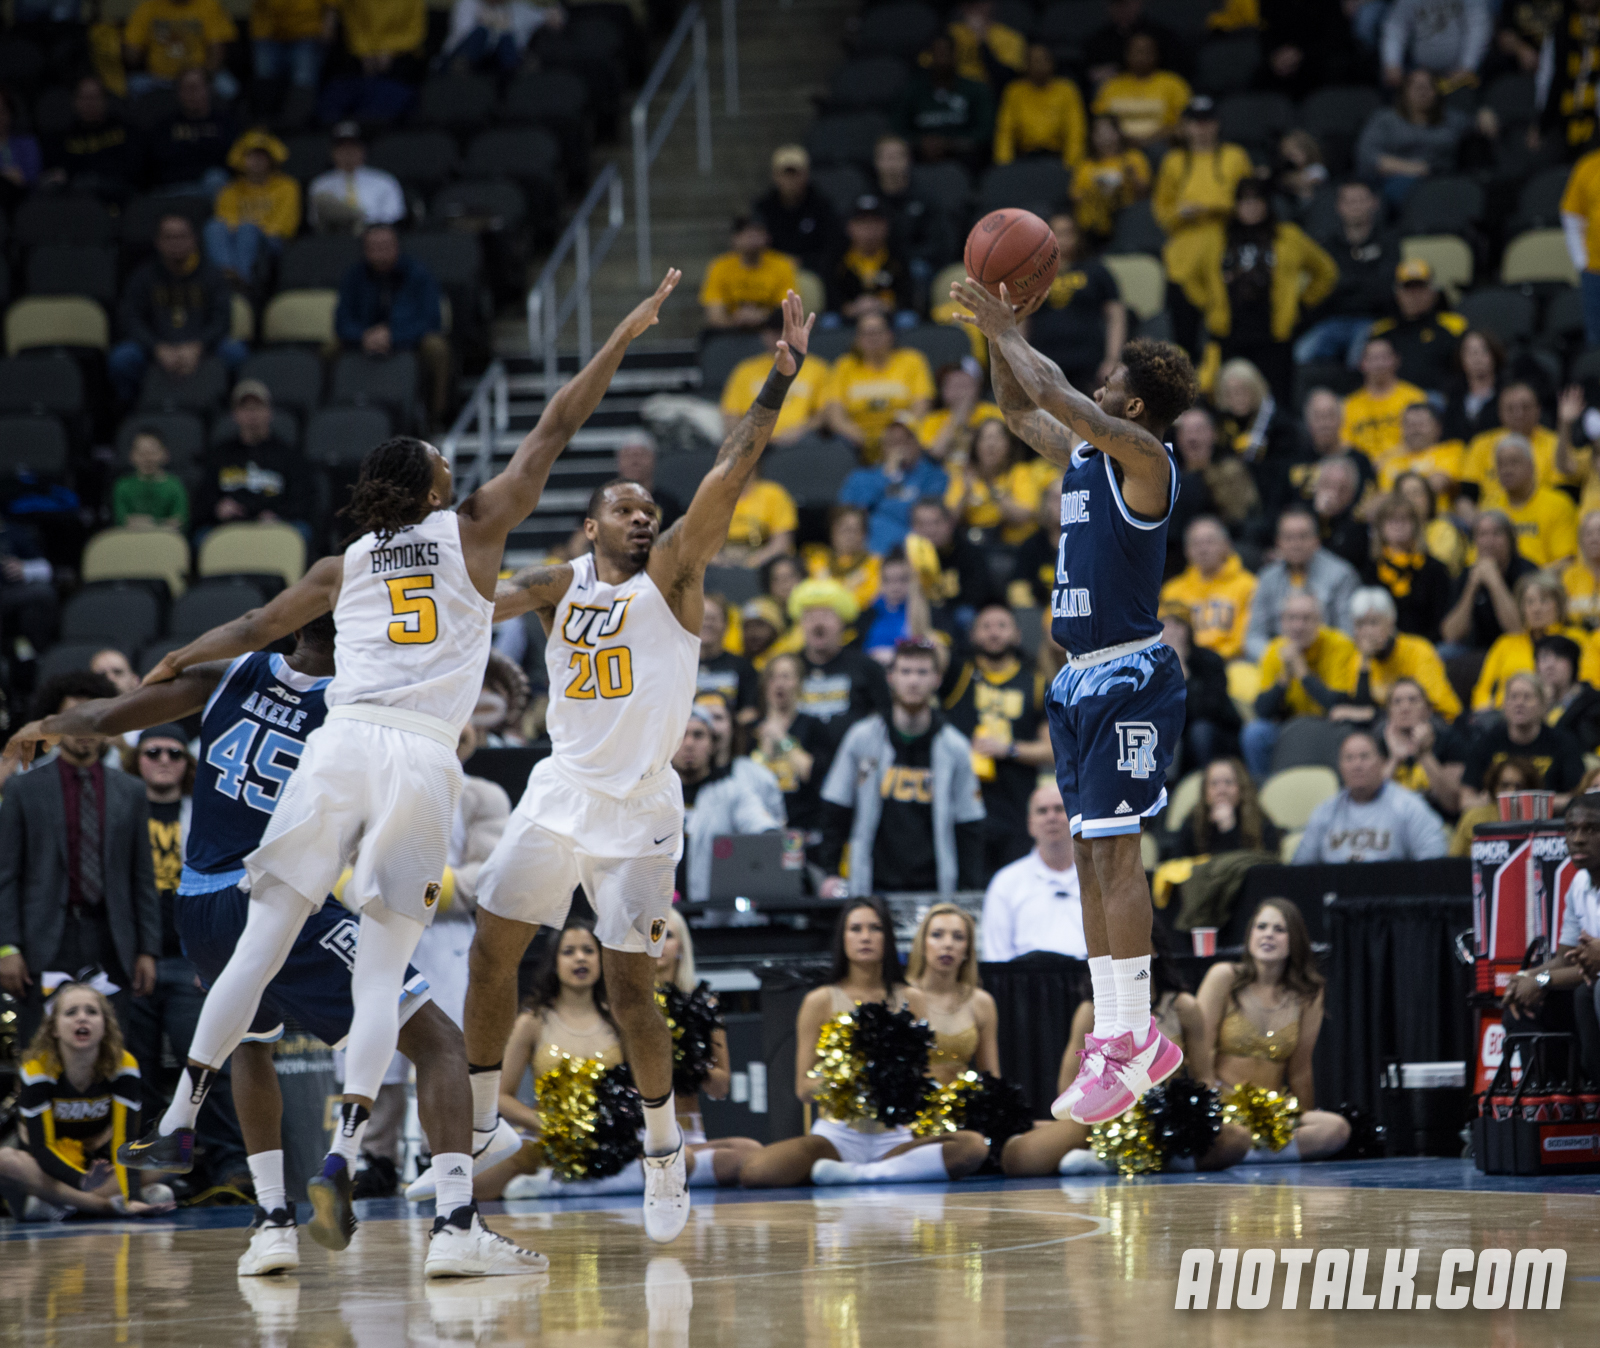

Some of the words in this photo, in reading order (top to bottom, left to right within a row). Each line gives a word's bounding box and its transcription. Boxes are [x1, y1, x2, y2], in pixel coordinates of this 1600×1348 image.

[1014, 245, 1060, 290] SPALDING
[370, 542, 440, 575] BROOKS
[1056, 532, 1070, 585] 1
[384, 573, 439, 645] 5
[561, 591, 639, 650] VCU
[565, 645, 634, 700] 20
[241, 691, 309, 733] AKELE
[206, 717, 308, 816] 45
[1114, 806, 1133, 815] adidas
[1329, 828, 1391, 851] VCU
[53, 1097, 113, 1121] RAMS
